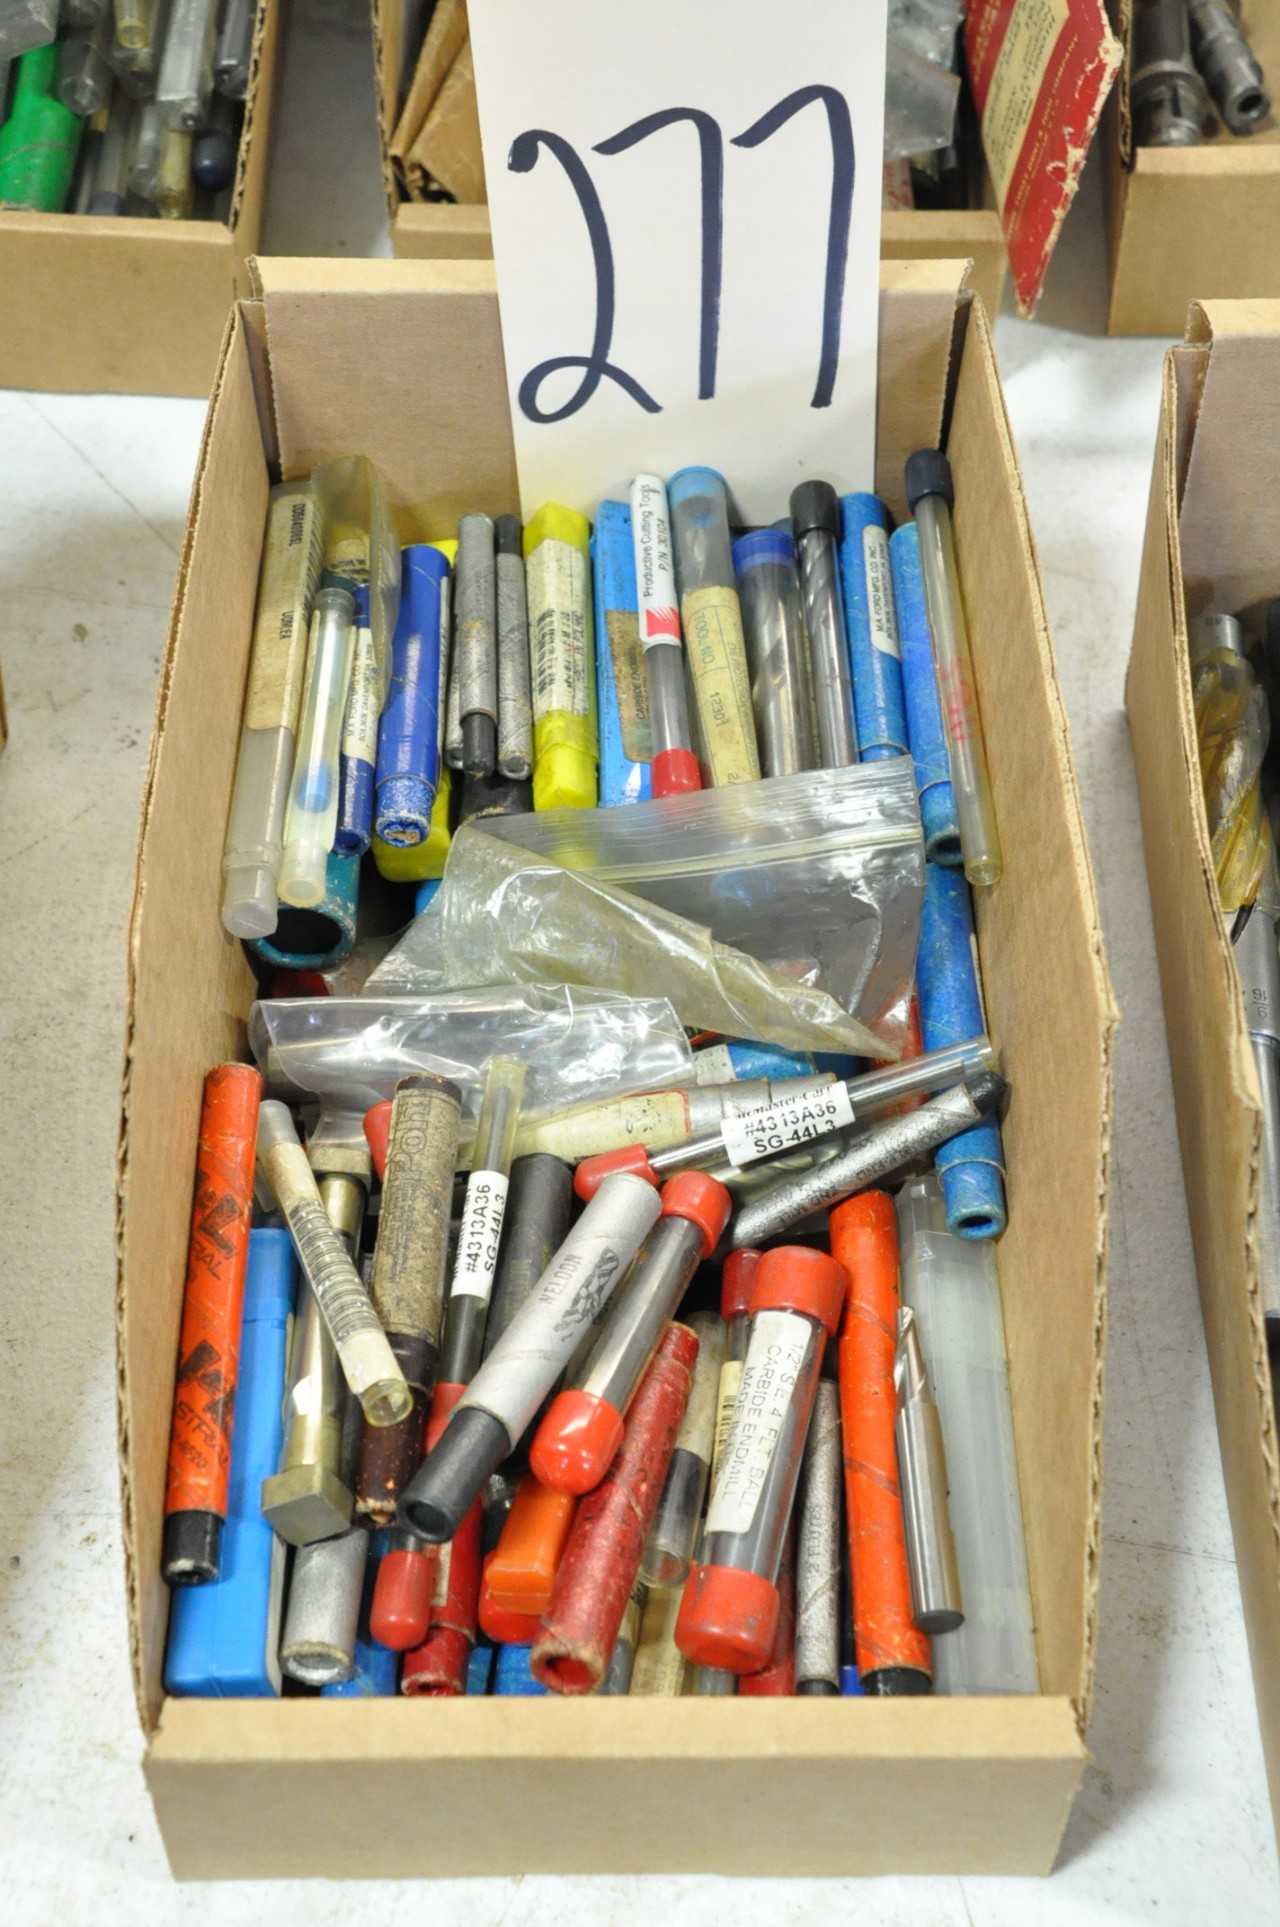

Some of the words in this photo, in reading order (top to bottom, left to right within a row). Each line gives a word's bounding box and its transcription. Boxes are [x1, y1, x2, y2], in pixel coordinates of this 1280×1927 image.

[507, 84, 856, 424] 277
[640, 484, 649, 507] Tools
[641, 511, 652, 542] Cutting
[643, 545, 652, 596] Productive
[744, 1101, 837, 1136] #4313A36
[465, 1184, 491, 1273] #4313A36
[537, 1254, 582, 1303] WELDON
[746, 1345, 781, 1420] CARBIDE
[720, 1423, 756, 1503] ENDMILL
